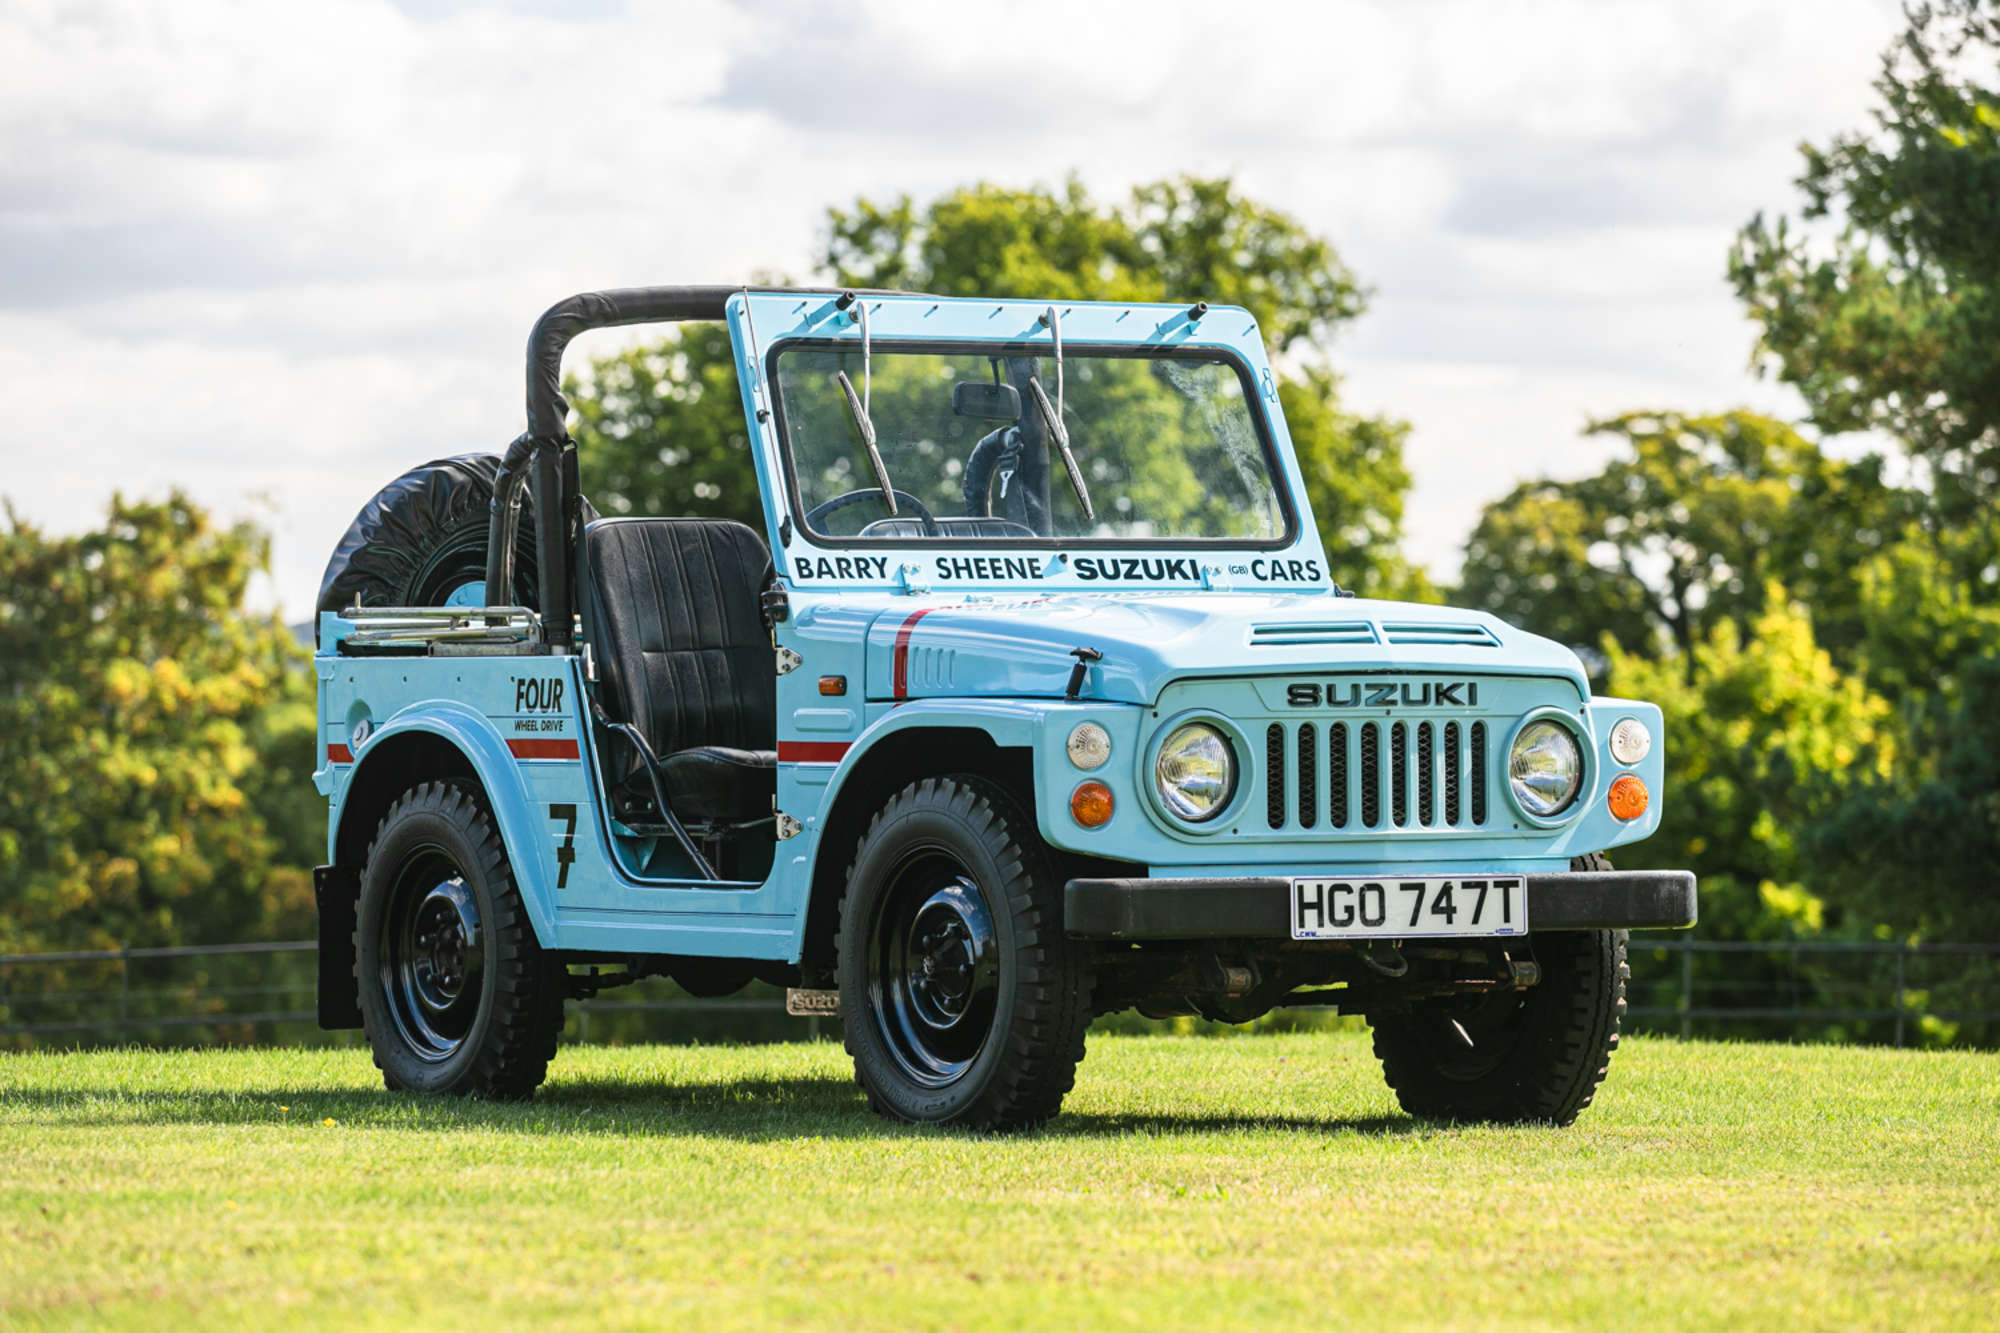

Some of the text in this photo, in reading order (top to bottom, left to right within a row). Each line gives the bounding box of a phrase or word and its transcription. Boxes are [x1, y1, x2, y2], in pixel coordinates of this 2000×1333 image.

[794, 556, 1321, 581] BARRY SHEENE SUZUKI (GB) CARS
[515, 677, 564, 713] FOUR
[1287, 682, 1478, 708] SUZUKI
[514, 720, 564, 732] WHEEL DRIVE
[549, 803, 577, 889] 7
[1297, 880, 1520, 929] HGO 747T
